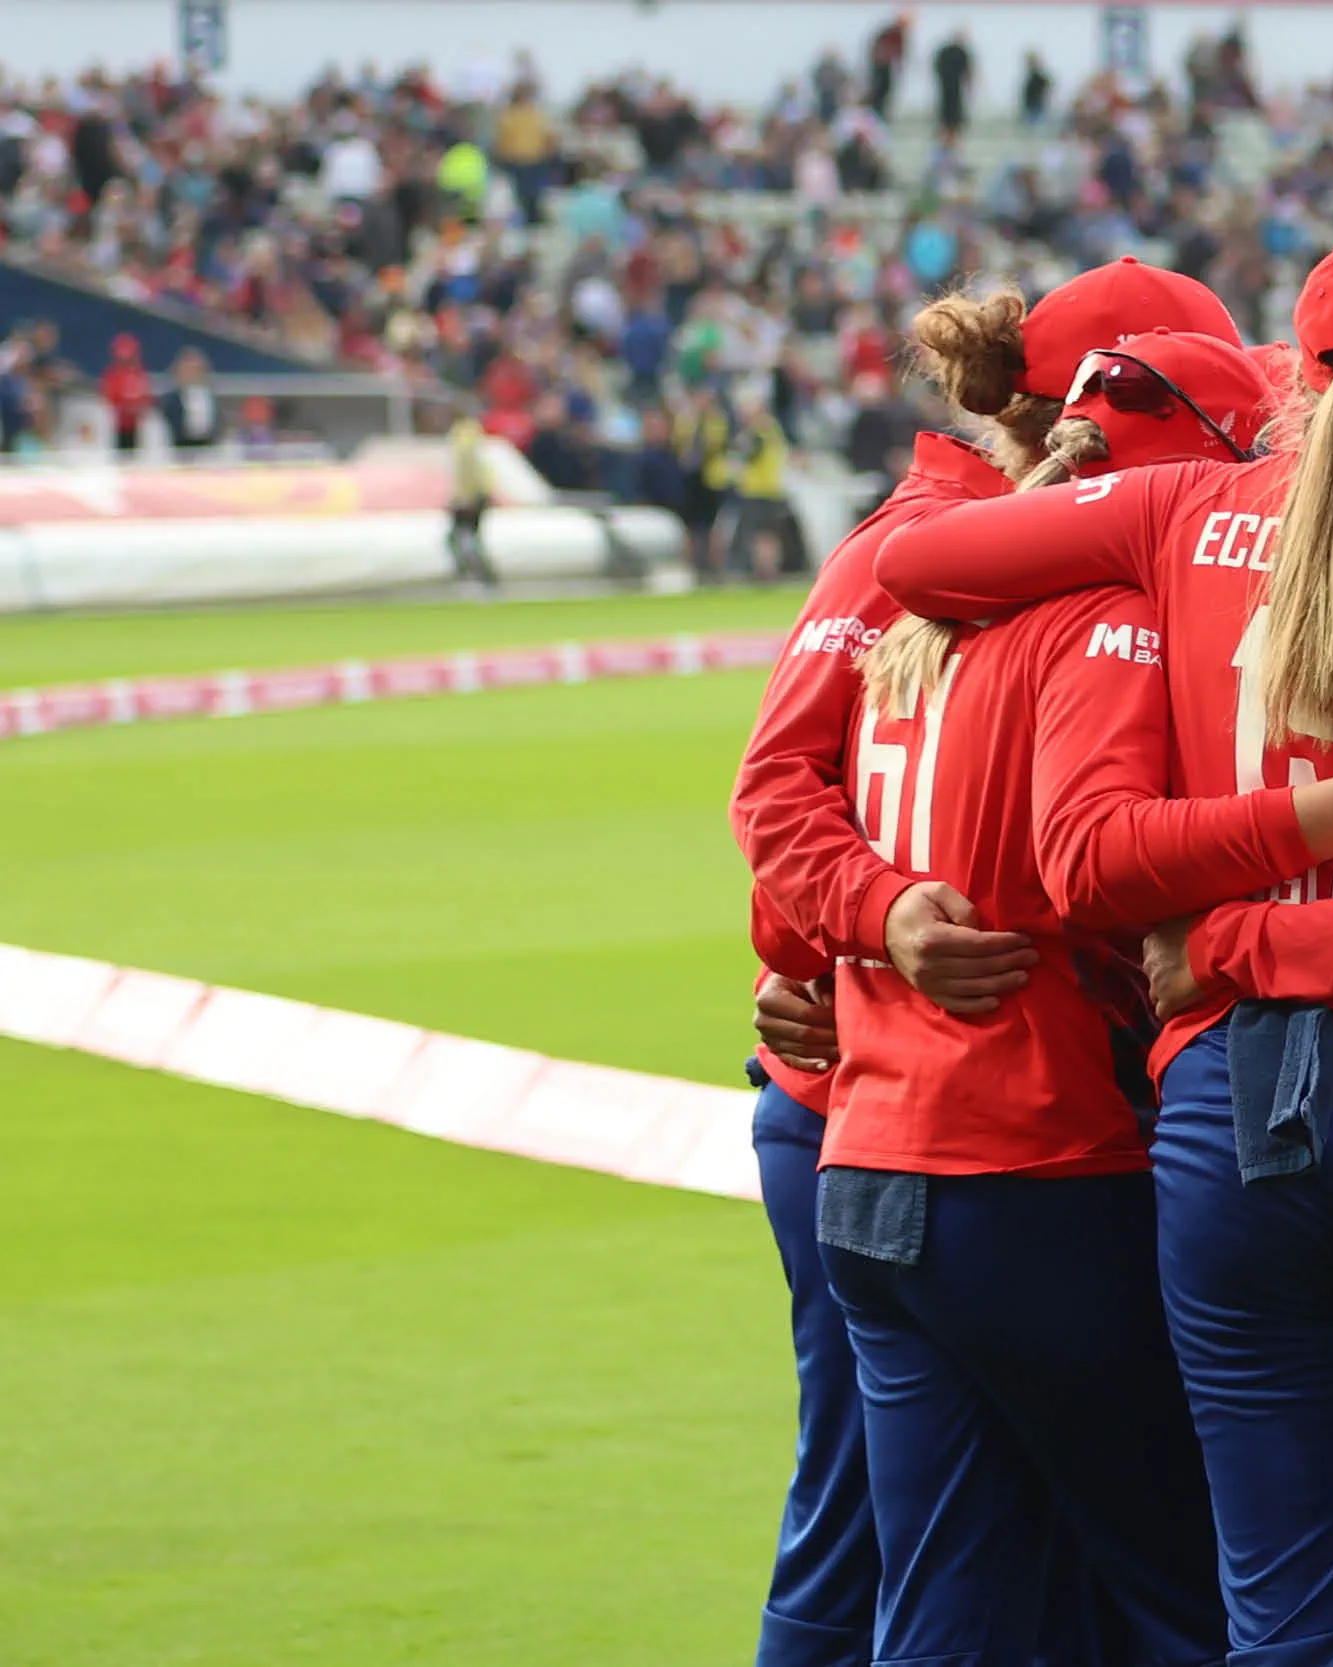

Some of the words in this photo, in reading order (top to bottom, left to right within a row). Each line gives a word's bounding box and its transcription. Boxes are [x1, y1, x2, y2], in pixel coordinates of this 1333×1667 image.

[791, 615, 882, 656] METRO
[1085, 622, 1160, 661] MET
[1133, 649, 1163, 671] BA
[856, 653, 963, 873] 61
